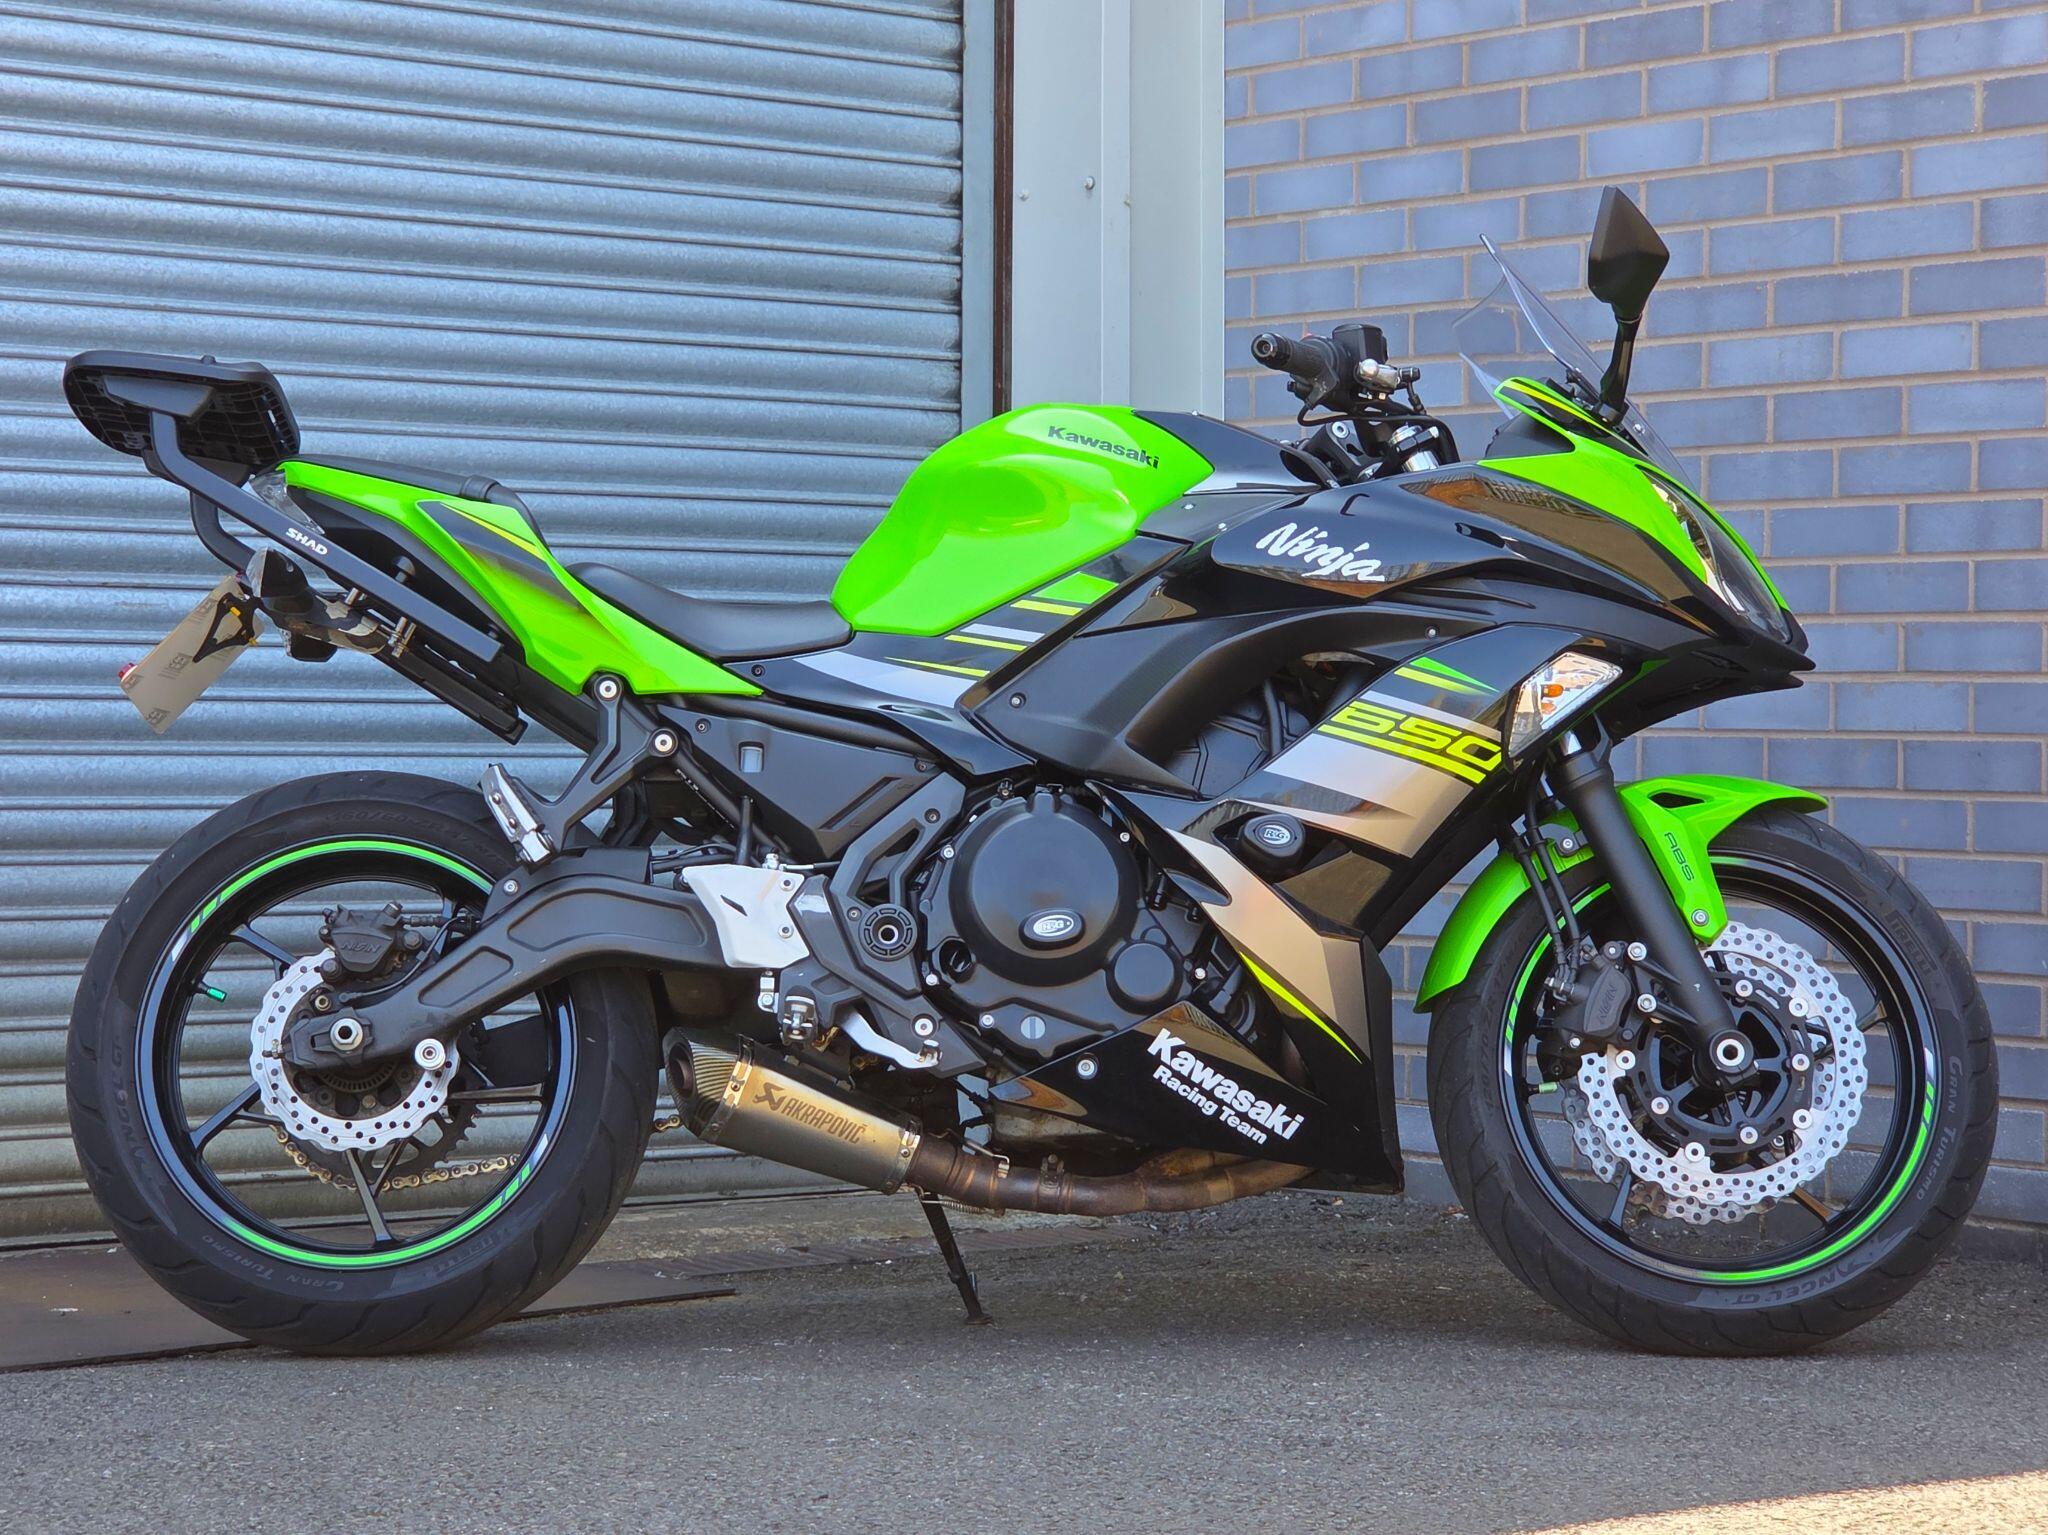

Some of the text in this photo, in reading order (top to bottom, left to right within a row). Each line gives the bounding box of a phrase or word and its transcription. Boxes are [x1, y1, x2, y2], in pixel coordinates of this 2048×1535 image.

[1047, 425, 1160, 469] Kawasaki
[285, 527, 328, 555] SHAD
[1255, 522, 1386, 582] Ninja
[1330, 700, 1502, 772] 650
[1664, 832, 1695, 881] ABS
[1146, 1027, 1305, 1140] Kawasaki
[1152, 1064, 1268, 1145] Racing Team
